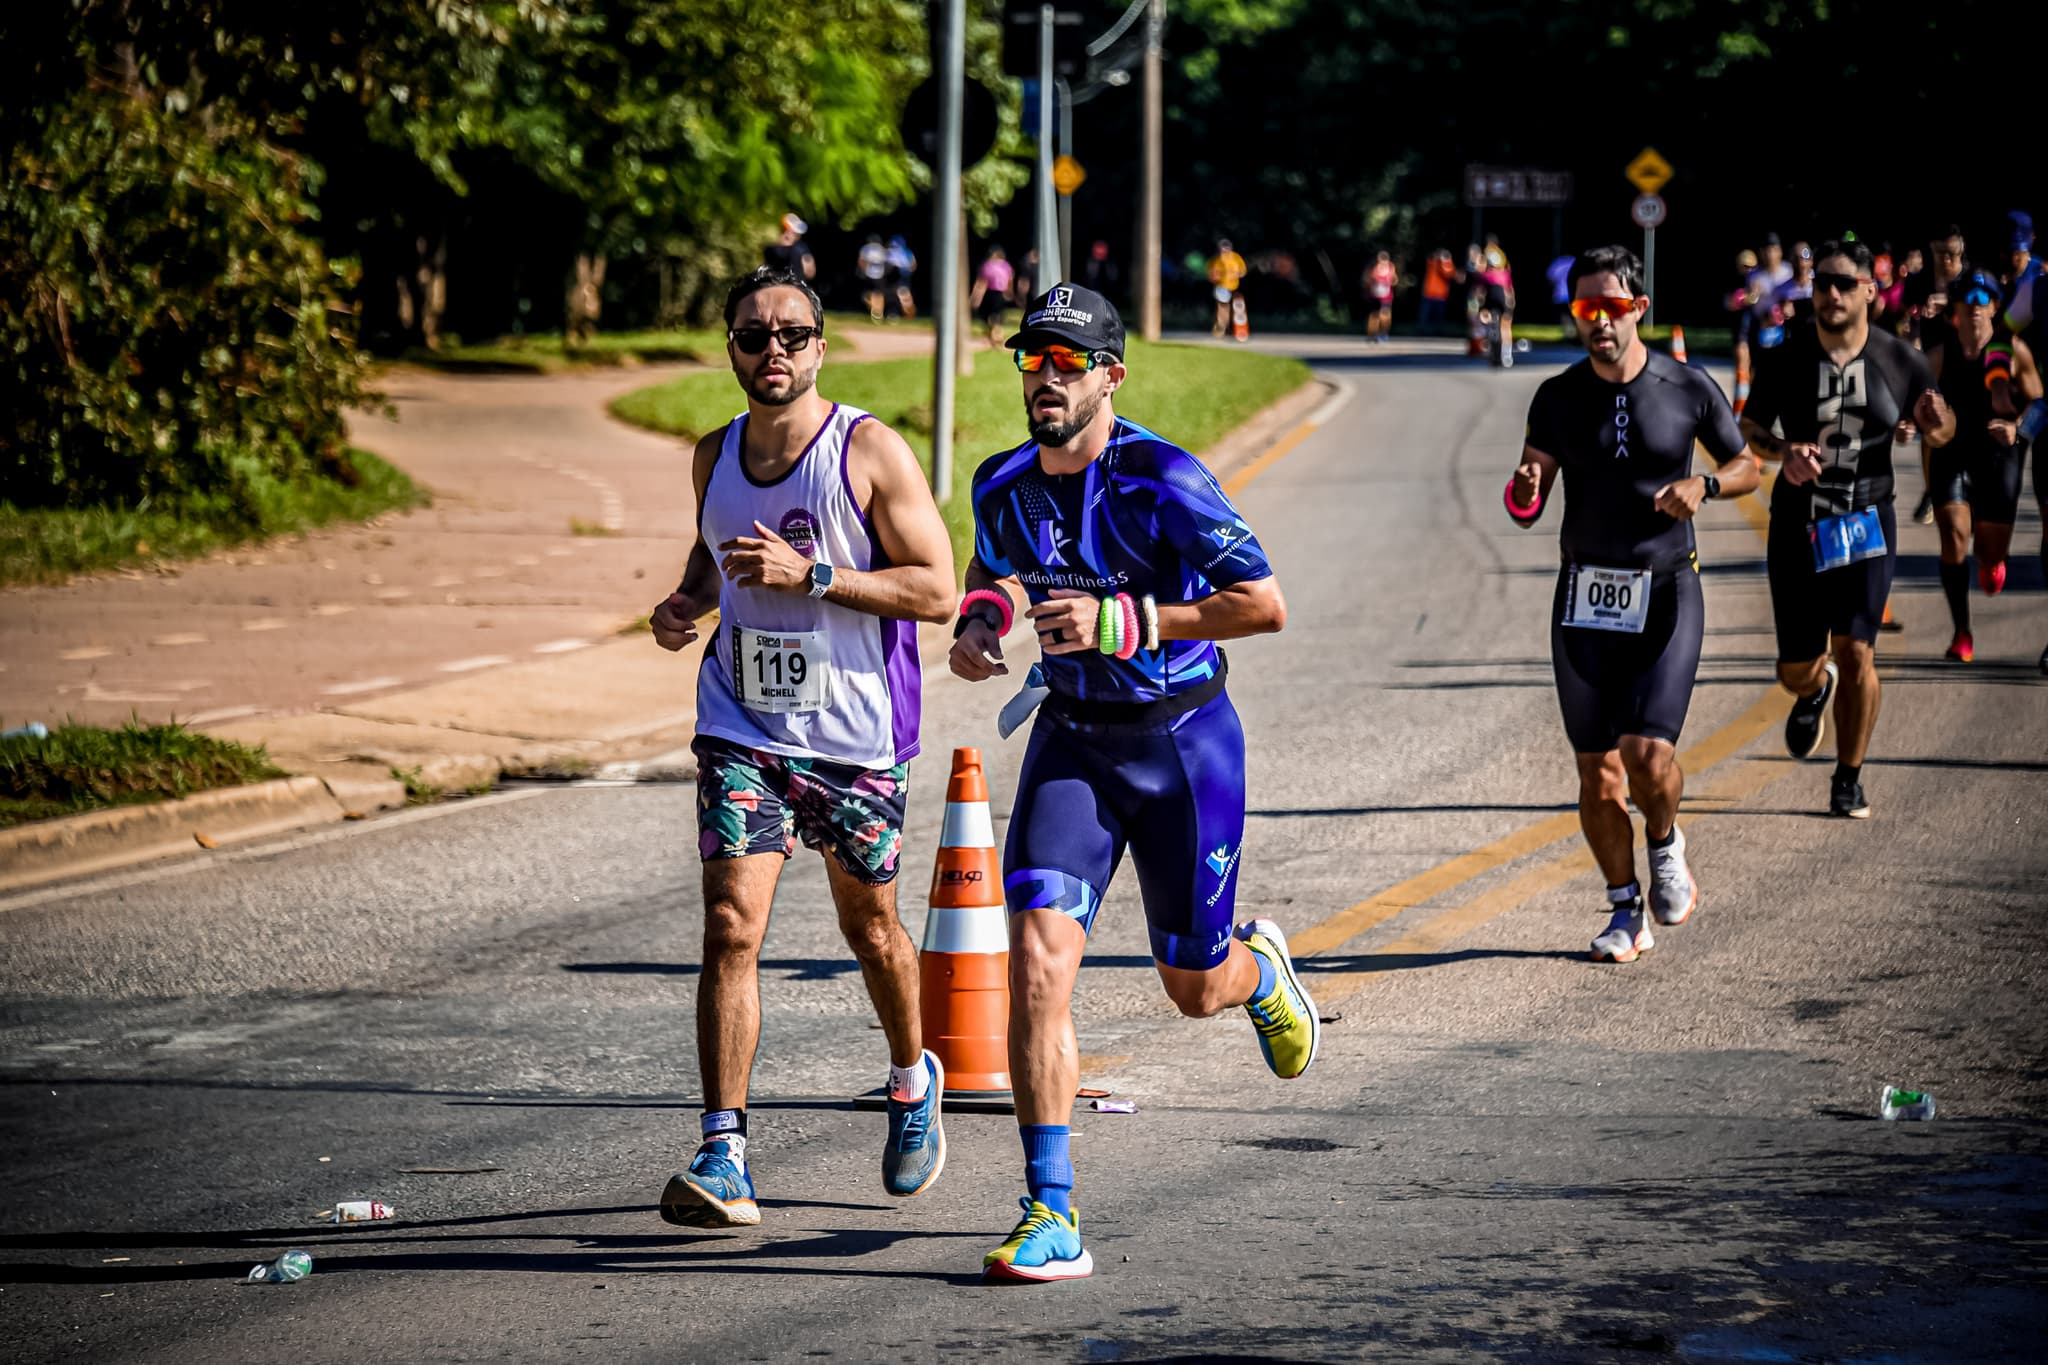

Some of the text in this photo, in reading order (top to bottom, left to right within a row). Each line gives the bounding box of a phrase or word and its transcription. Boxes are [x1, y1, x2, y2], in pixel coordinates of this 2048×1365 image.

[1588, 582, 1631, 610] 080
[753, 649, 807, 685] 119
[761, 687, 797, 698] MICHELL
